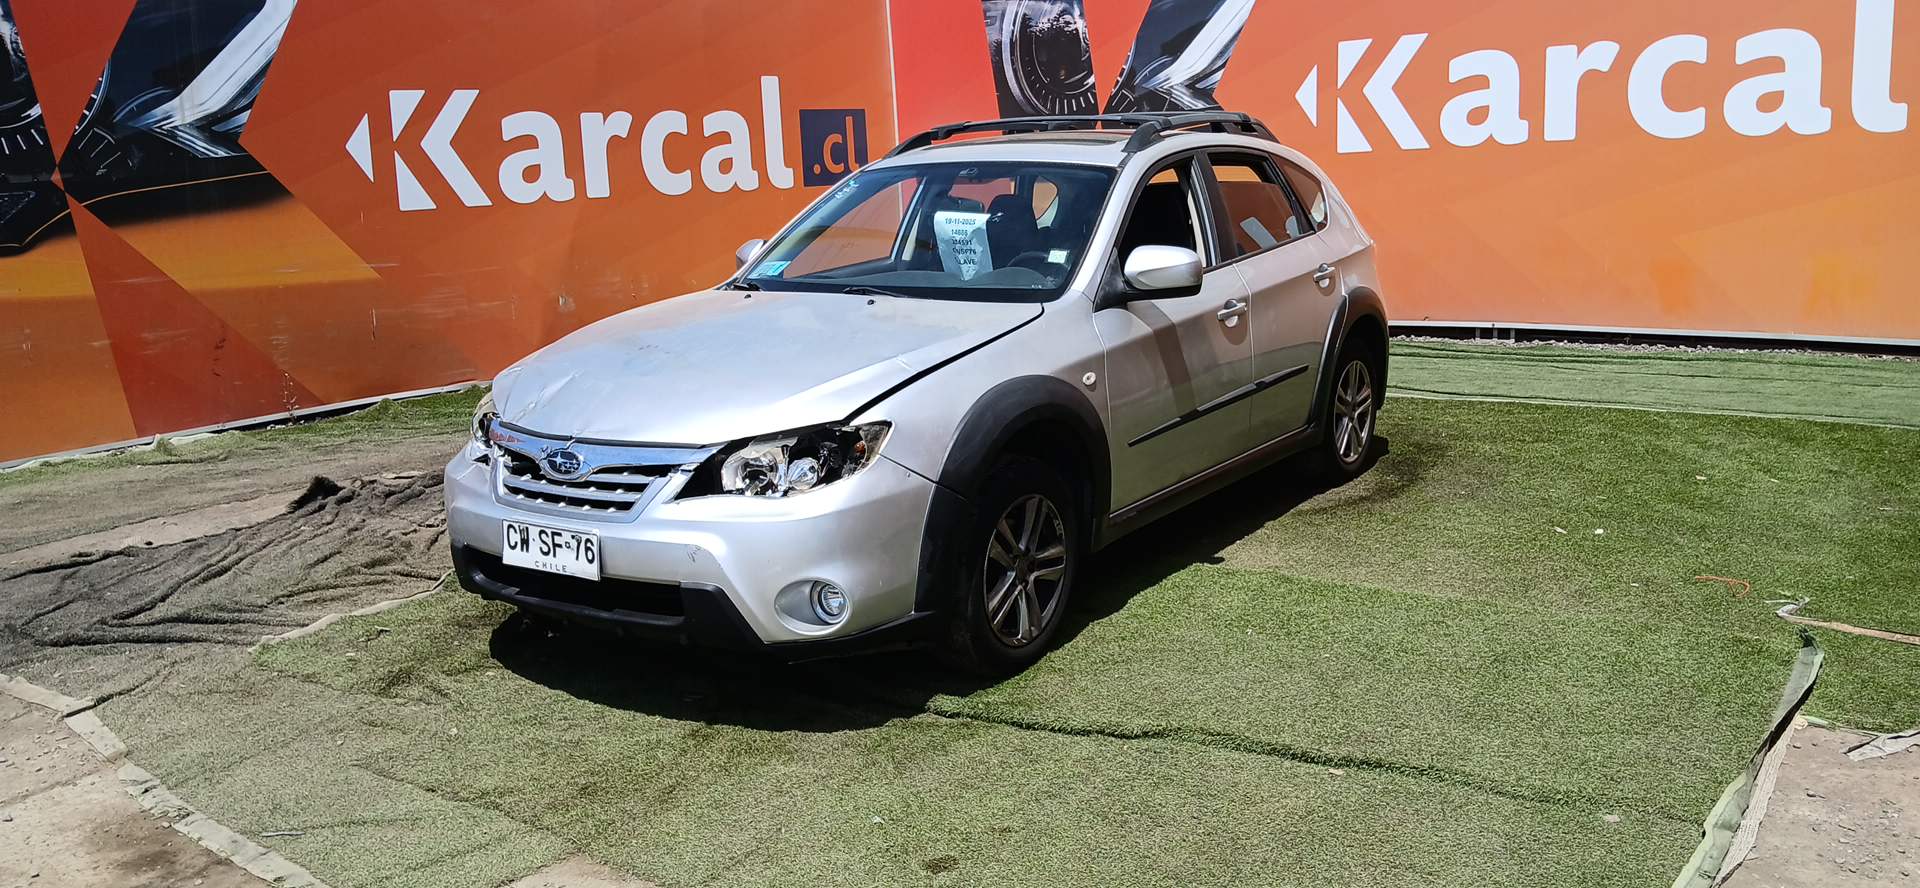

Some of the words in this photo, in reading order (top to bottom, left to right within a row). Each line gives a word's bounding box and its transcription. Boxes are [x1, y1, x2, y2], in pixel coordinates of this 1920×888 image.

[1337, 0, 1908, 153] Karcal
[389, 76, 794, 211] Karcal
[813, 116, 860, 173] .cl
[945, 217, 976, 225] 19-11-2025
[534, 560, 568, 572] CHILE
